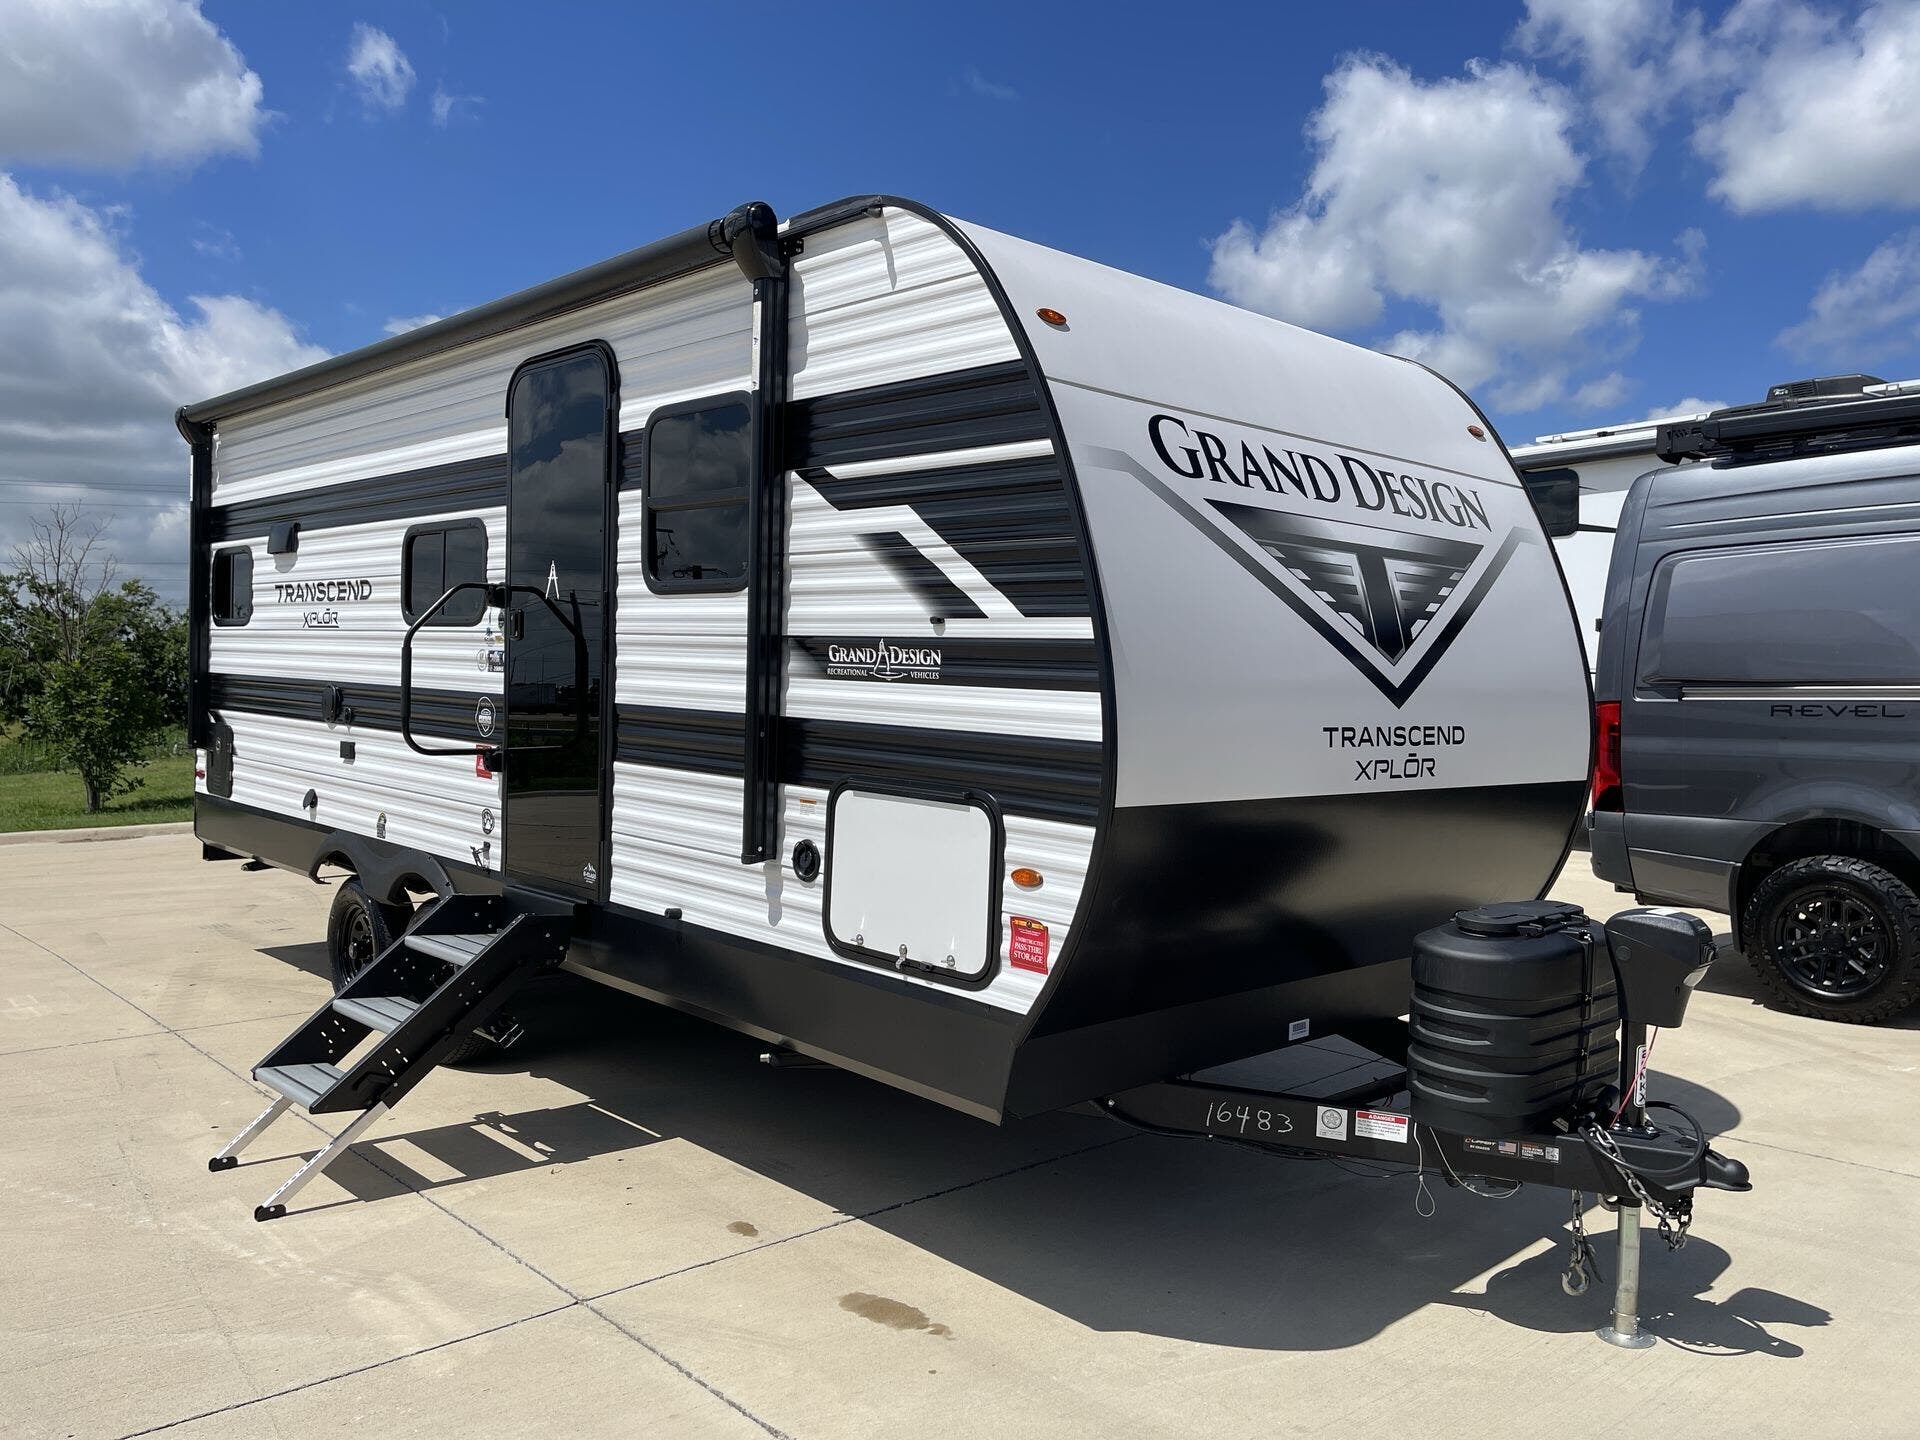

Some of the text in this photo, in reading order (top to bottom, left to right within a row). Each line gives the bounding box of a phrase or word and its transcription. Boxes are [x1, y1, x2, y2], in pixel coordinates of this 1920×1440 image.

[1148, 414, 1493, 533] GRAND DESIGN
[274, 579, 373, 603] TRANSCEND
[828, 644, 941, 666] GRAND DESIGN
[827, 667, 940, 680] RECREATIONAL VEHICLES
[1770, 704, 1906, 718] REVEL
[1322, 725, 1466, 748] TRANSCEND
[1013, 950, 1044, 964] STORAGE
[1206, 1102, 1294, 1133] 16483
